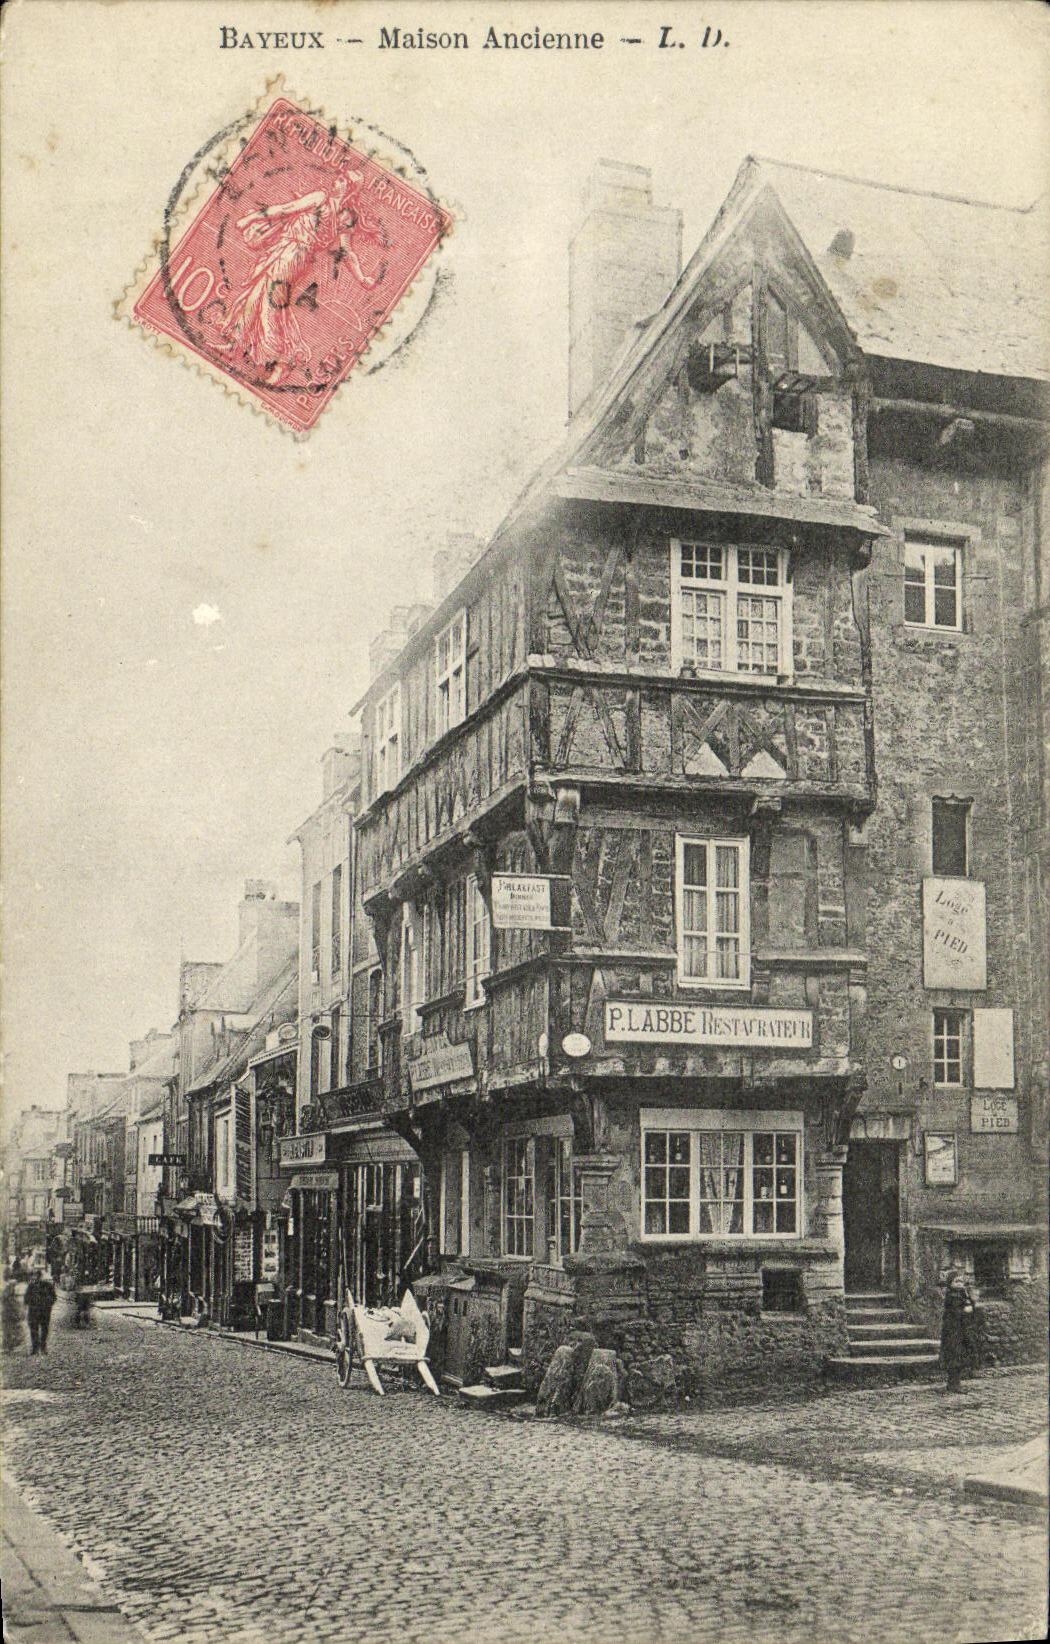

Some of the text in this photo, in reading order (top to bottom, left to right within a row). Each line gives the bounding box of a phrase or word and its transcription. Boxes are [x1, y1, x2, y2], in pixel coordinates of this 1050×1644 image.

[367, 176, 440, 234] FRANÇAISE
[295, 334, 356, 412] POSTES
[934, 929, 969, 954] PIED
[701, 1011, 812, 1040] RESTAURATEUR
[981, 1117, 1010, 1128] PIED
